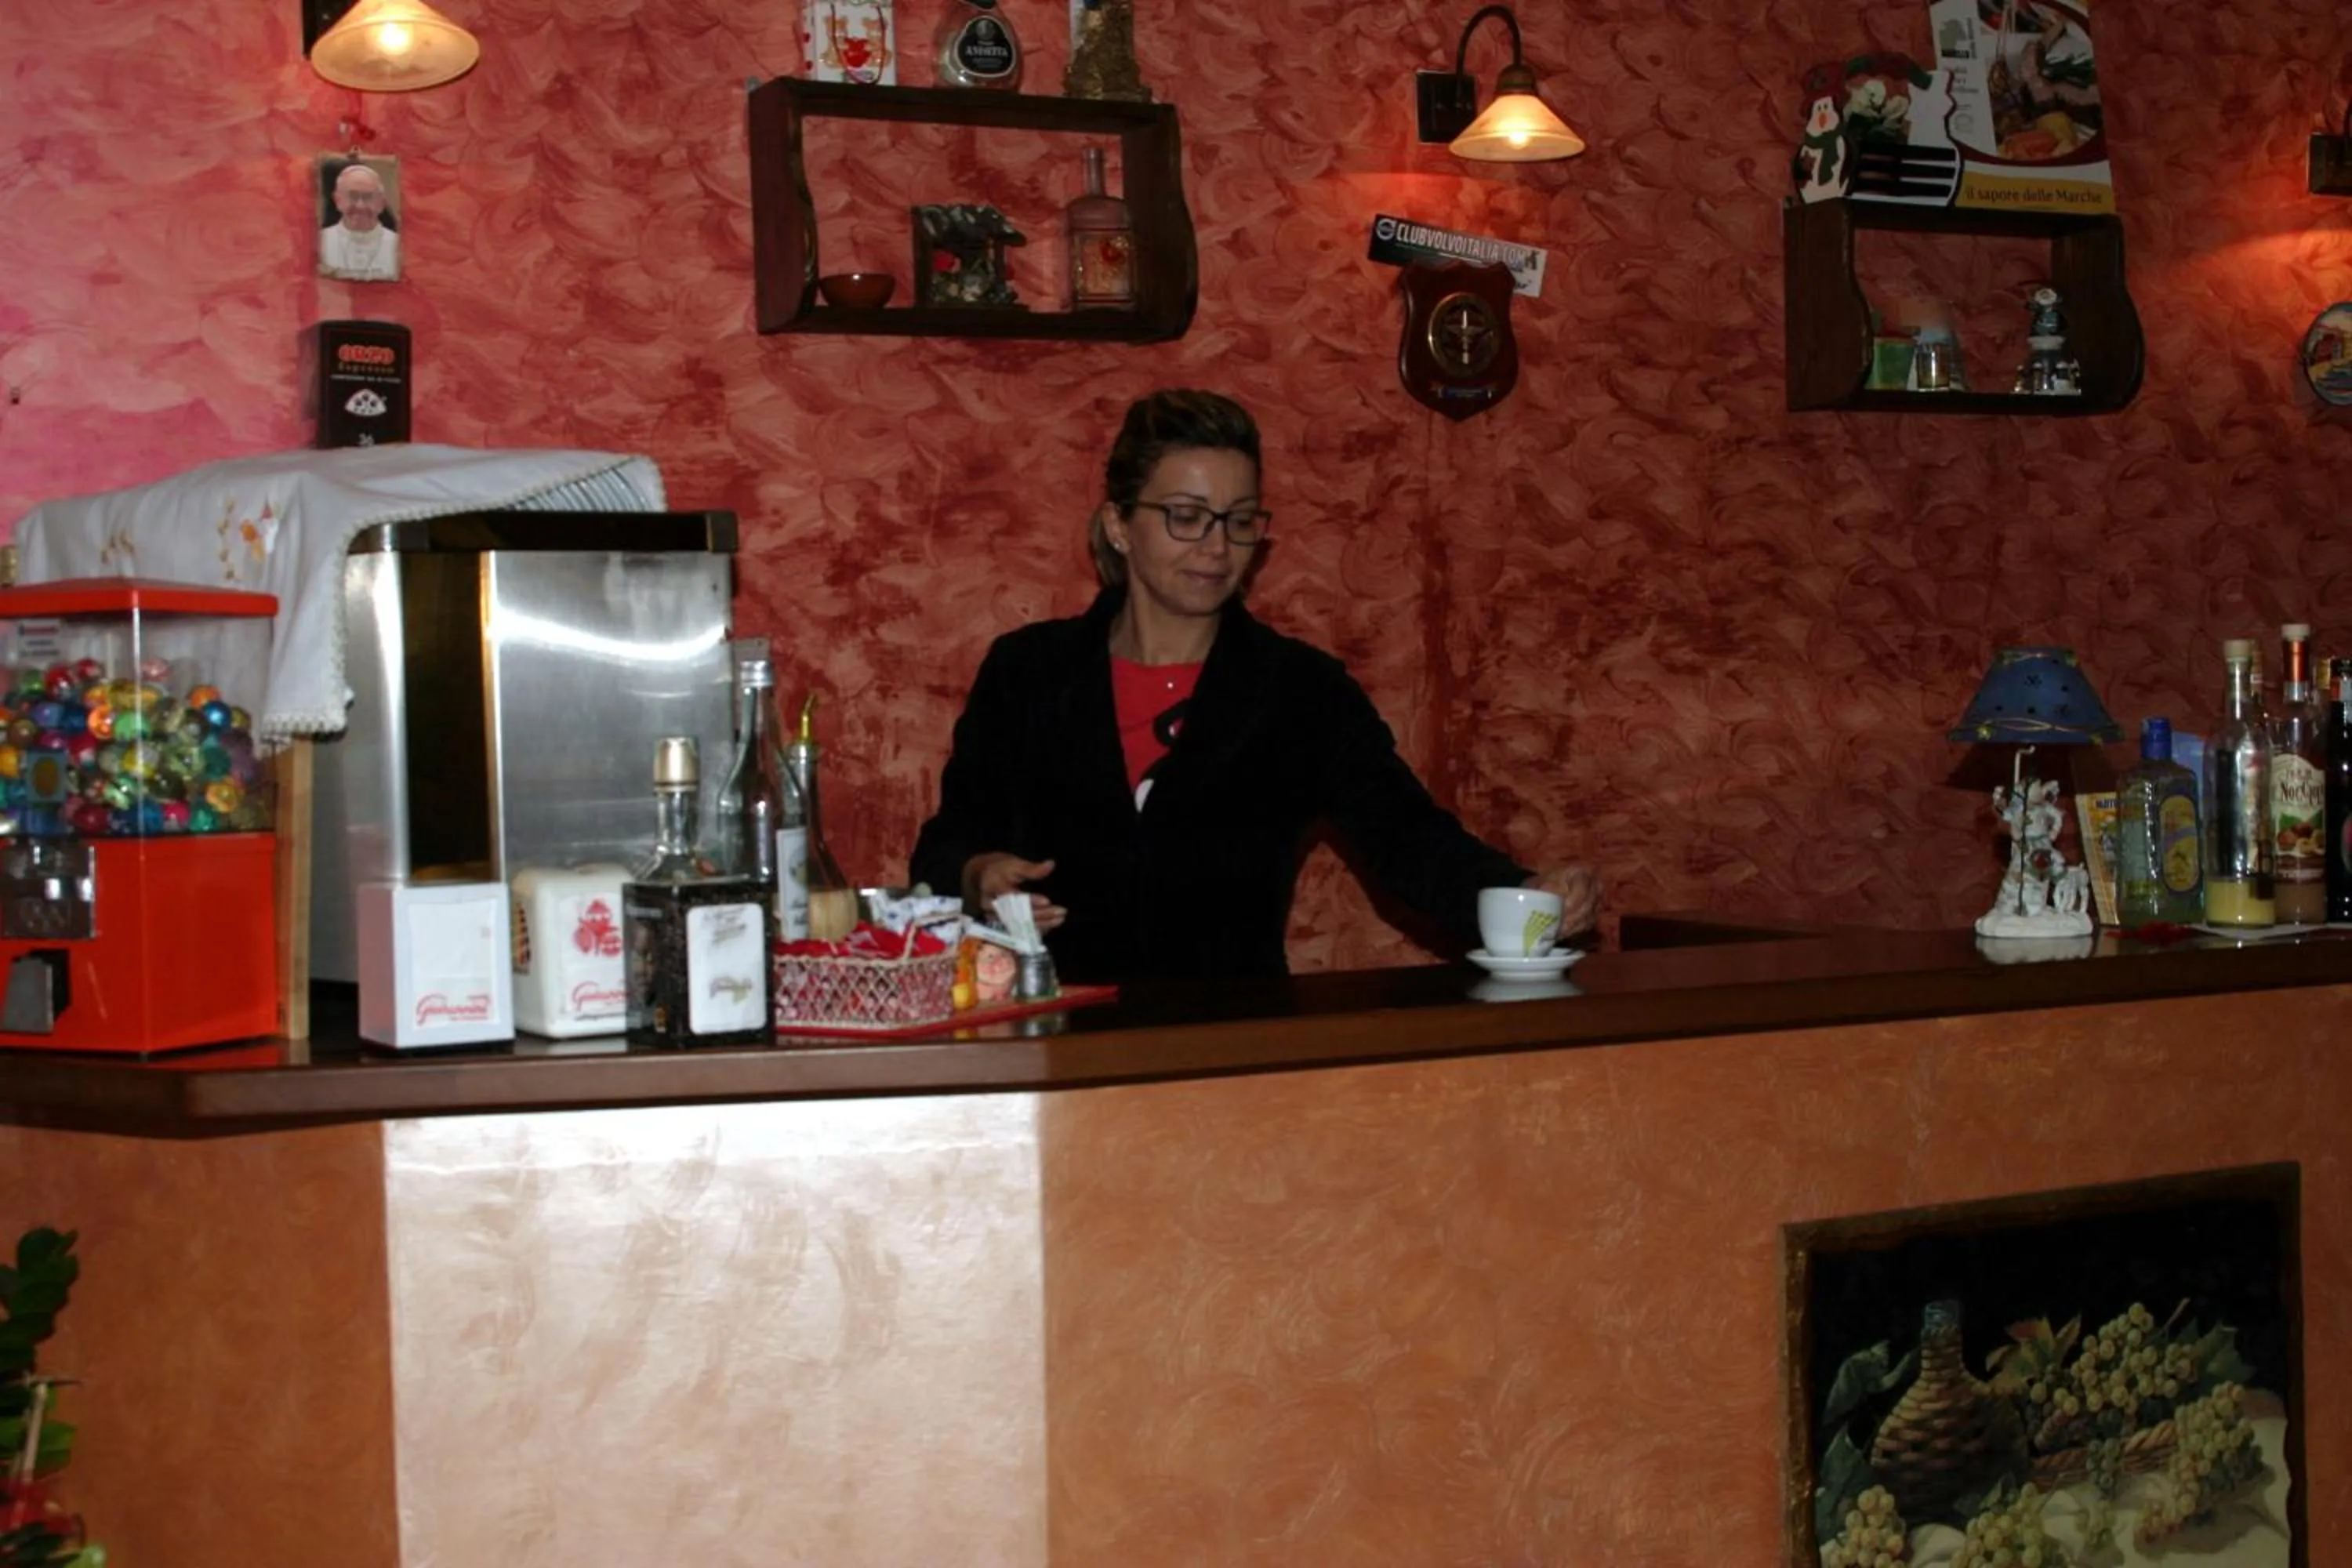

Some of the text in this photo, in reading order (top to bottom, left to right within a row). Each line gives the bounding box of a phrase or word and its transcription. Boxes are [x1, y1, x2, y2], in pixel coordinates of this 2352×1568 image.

[1965, 187, 2103, 204] il sapore delle Marche
